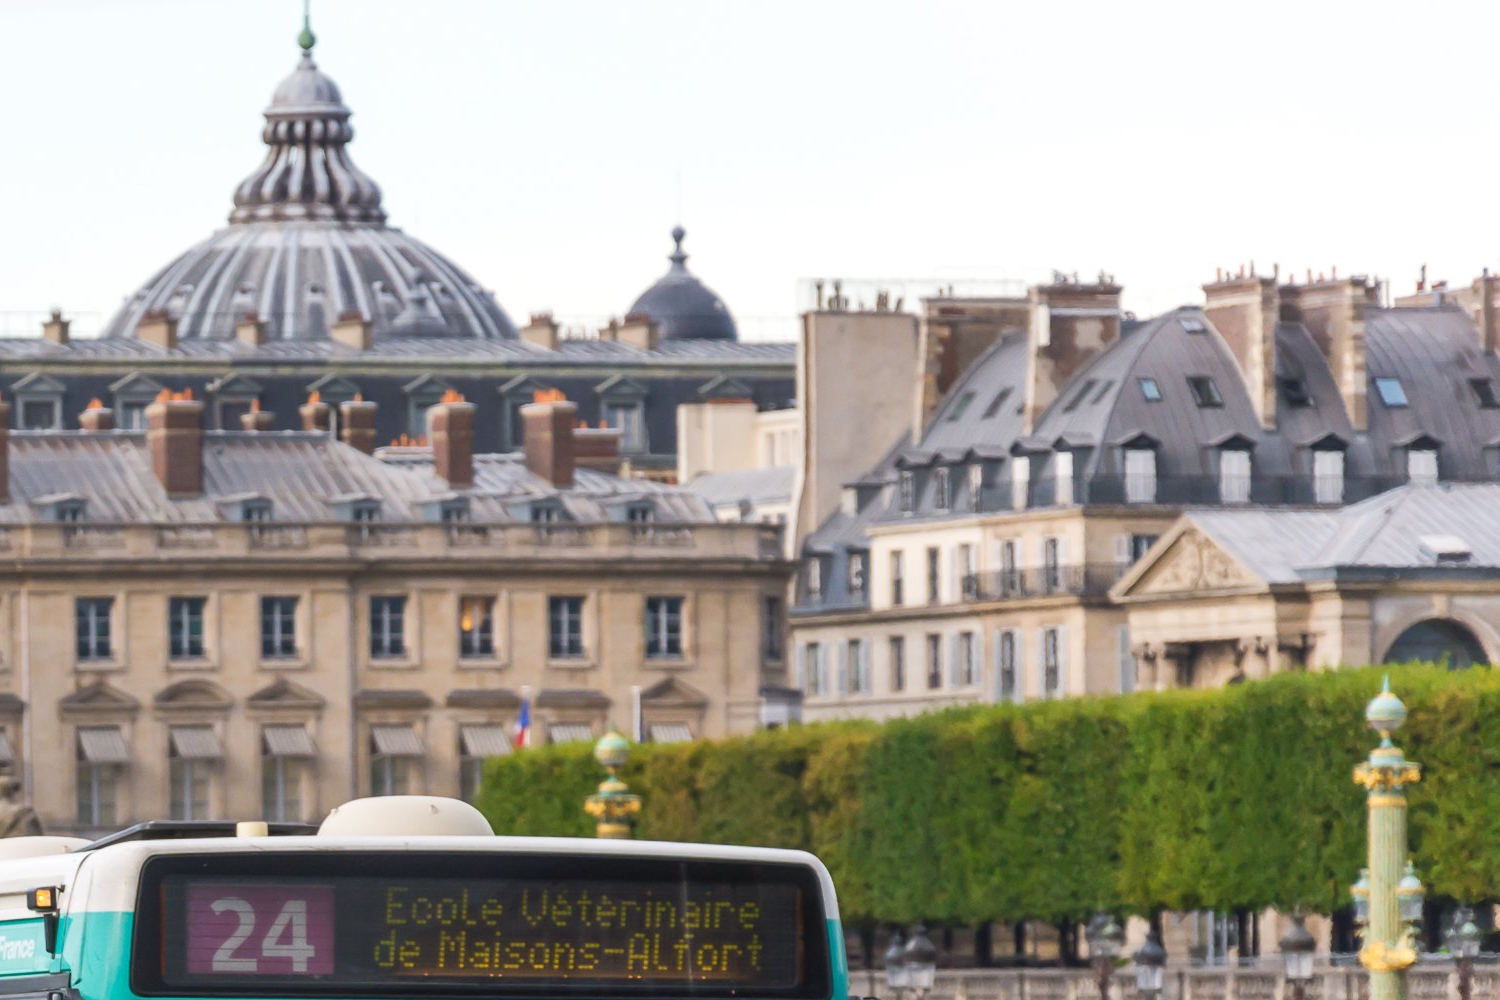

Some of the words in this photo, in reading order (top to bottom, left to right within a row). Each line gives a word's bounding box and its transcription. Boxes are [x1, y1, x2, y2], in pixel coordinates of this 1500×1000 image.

[384, 888, 503, 926] Ecole
[521, 887, 761, 930] Vétérinaire
[210, 896, 316, 973] 24
[375, 938, 418, 969] de
[436, 931, 763, 973] Maisons-Alfort
